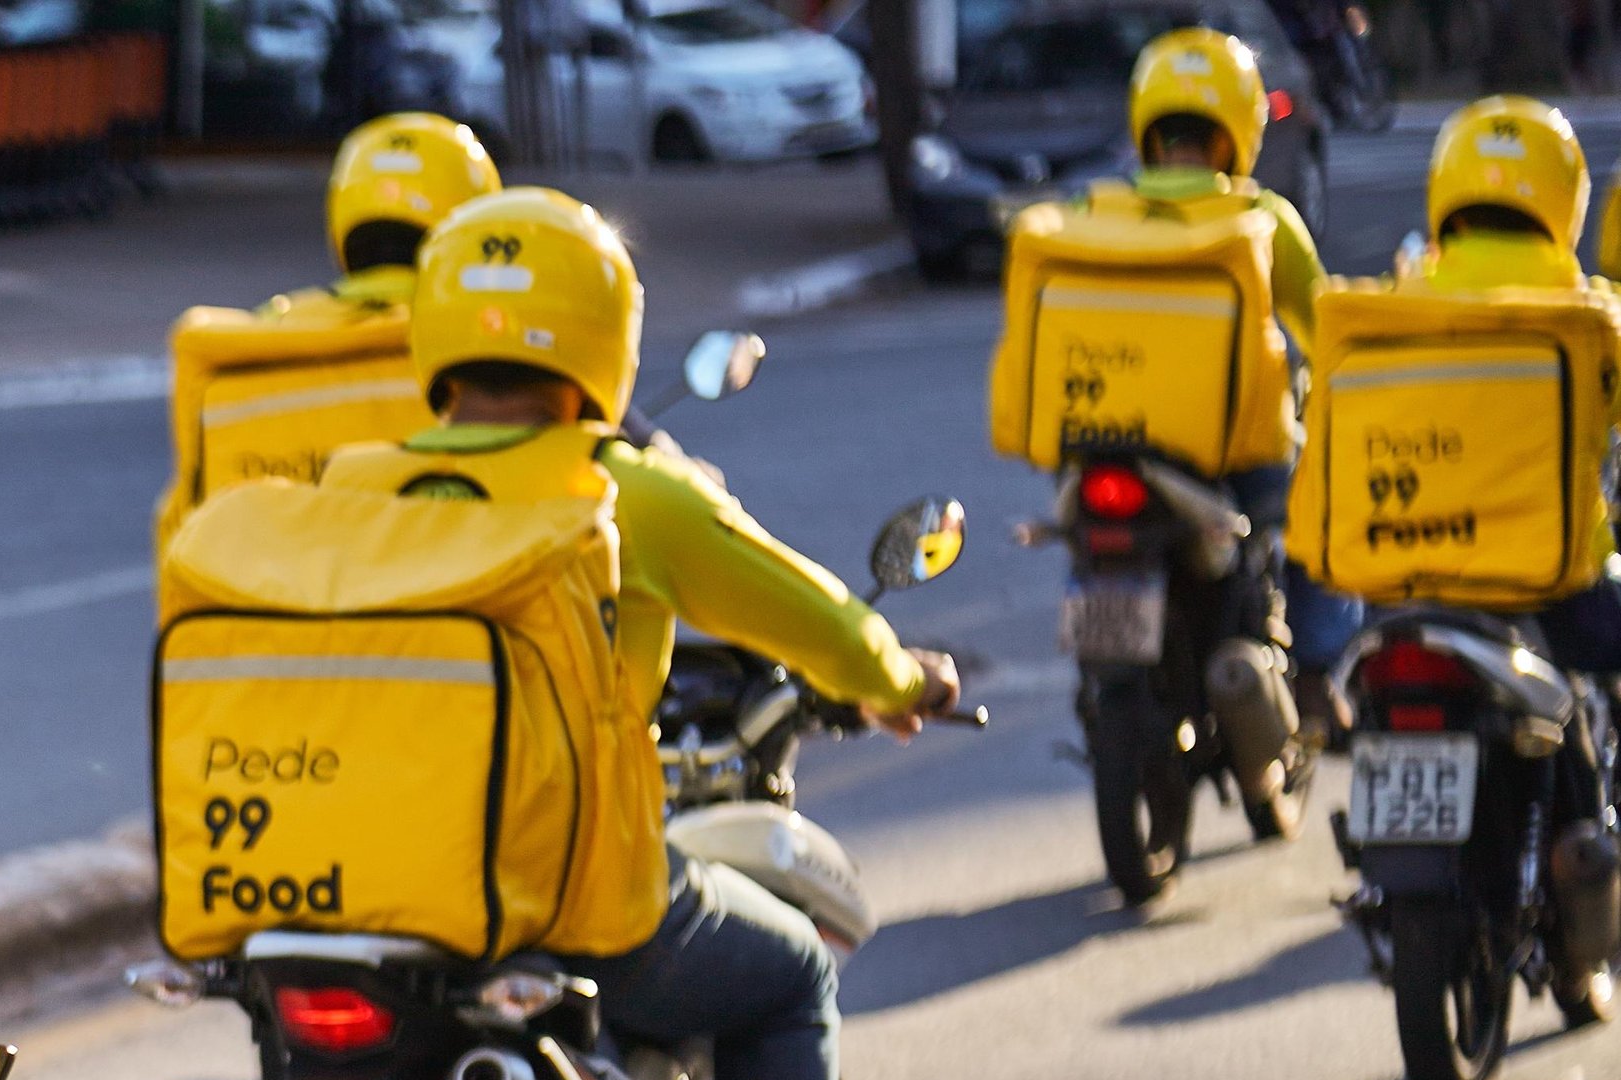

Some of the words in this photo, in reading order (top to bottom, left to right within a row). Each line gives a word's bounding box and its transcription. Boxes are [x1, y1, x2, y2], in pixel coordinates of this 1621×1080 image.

[481, 234, 522, 265] 99
[1365, 424, 1463, 465] Pede
[1369, 469, 1420, 515] 99
[1368, 509, 1477, 553] Food
[205, 736, 340, 786] Pede
[204, 796, 272, 851] 99
[202, 862, 344, 914] Food
